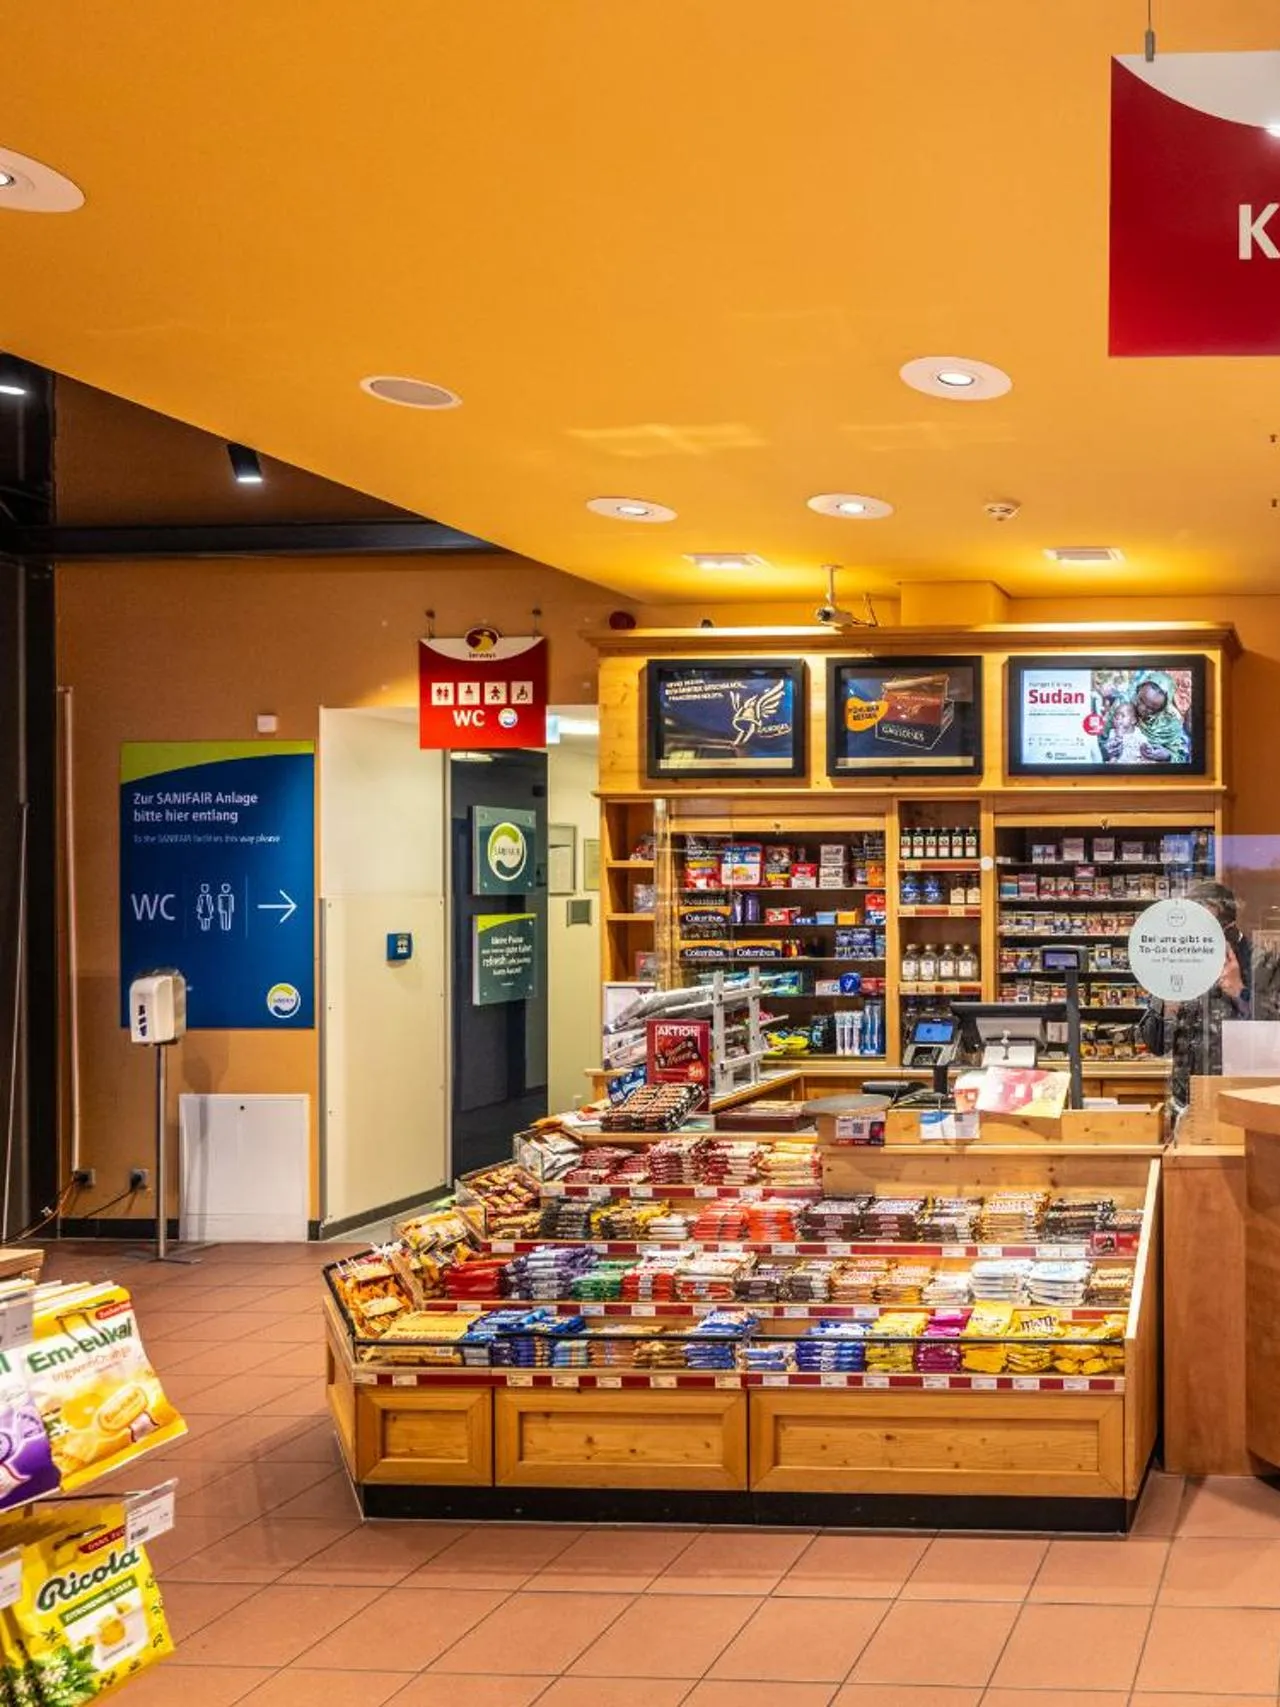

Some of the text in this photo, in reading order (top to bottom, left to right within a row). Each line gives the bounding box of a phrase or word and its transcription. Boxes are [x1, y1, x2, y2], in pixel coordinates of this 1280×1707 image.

[1028, 689, 1085, 704] Sudan
[452, 709, 486, 727] WC
[133, 792, 259, 806] Zur SANIFAIR Anlage
[134, 809, 238, 824] bitte hier entlang
[131, 893, 175, 920] WC
[685, 914, 724, 923] Columbus
[1141, 935, 1155, 943] Bei
[1180, 935, 1200, 944] gibt
[737, 948, 775, 957] Columbus
[658, 1025, 698, 1036] AKTION
[27, 1317, 132, 1373] Em-eukal
[37, 1549, 140, 1611] Ricola
